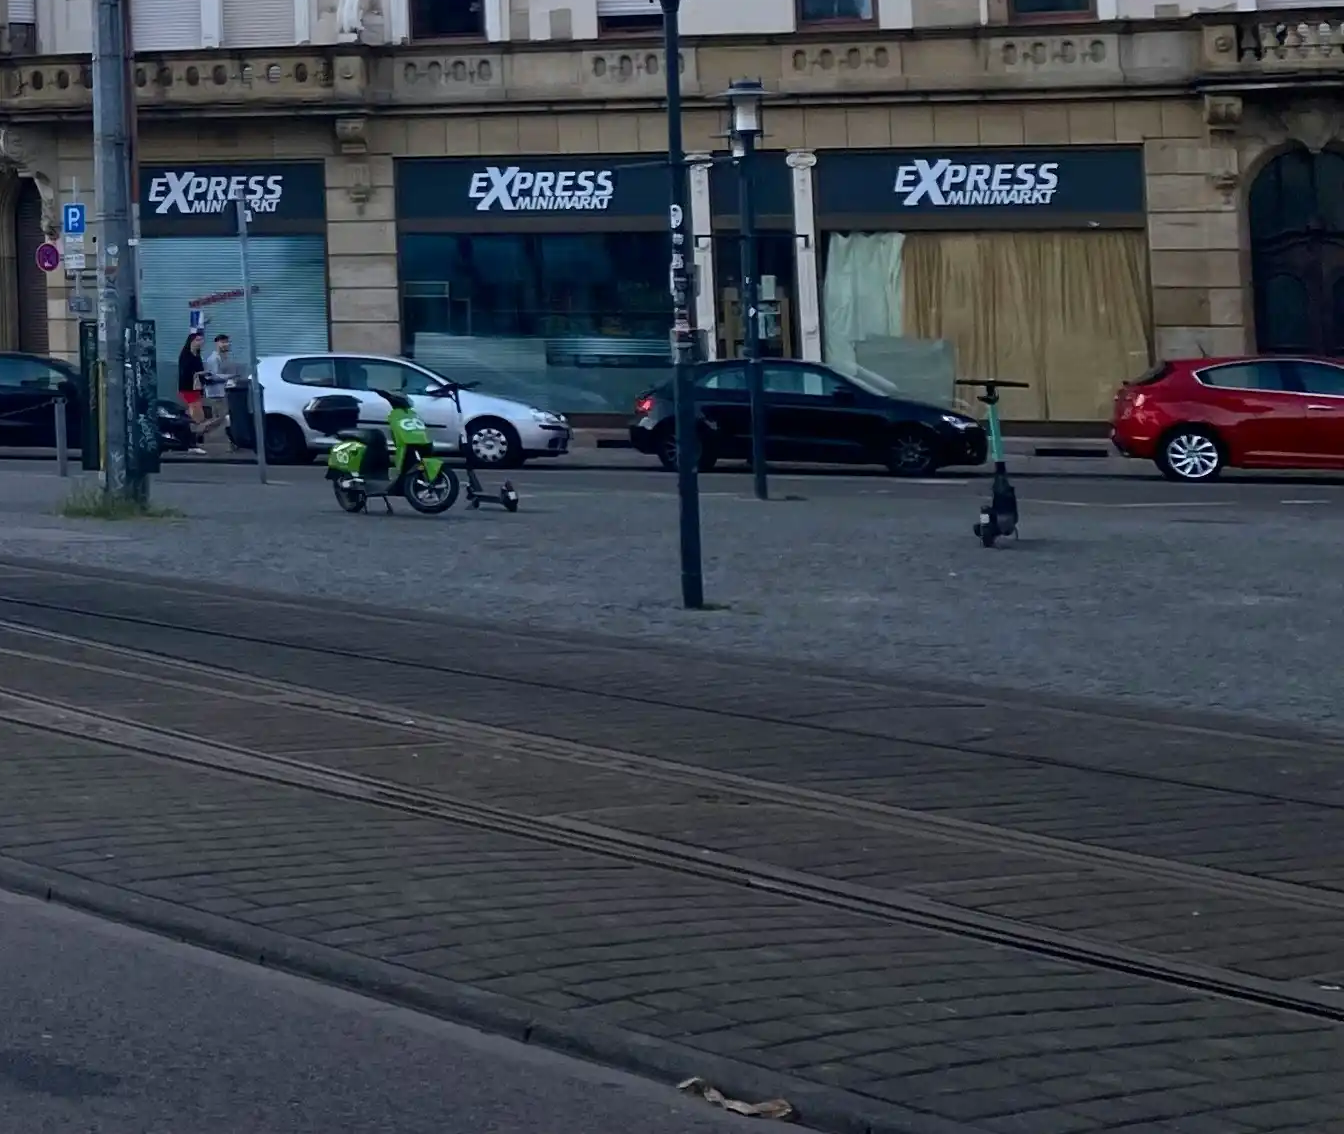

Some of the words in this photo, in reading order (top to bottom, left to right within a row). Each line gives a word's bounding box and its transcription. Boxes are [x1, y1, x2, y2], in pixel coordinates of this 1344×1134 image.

[514, 195, 613, 211] MINIMARKT
[947, 189, 1057, 206] MINIMARKT
[190, 198, 281, 214] MINIRKT
[68, 207, 81, 231] P
